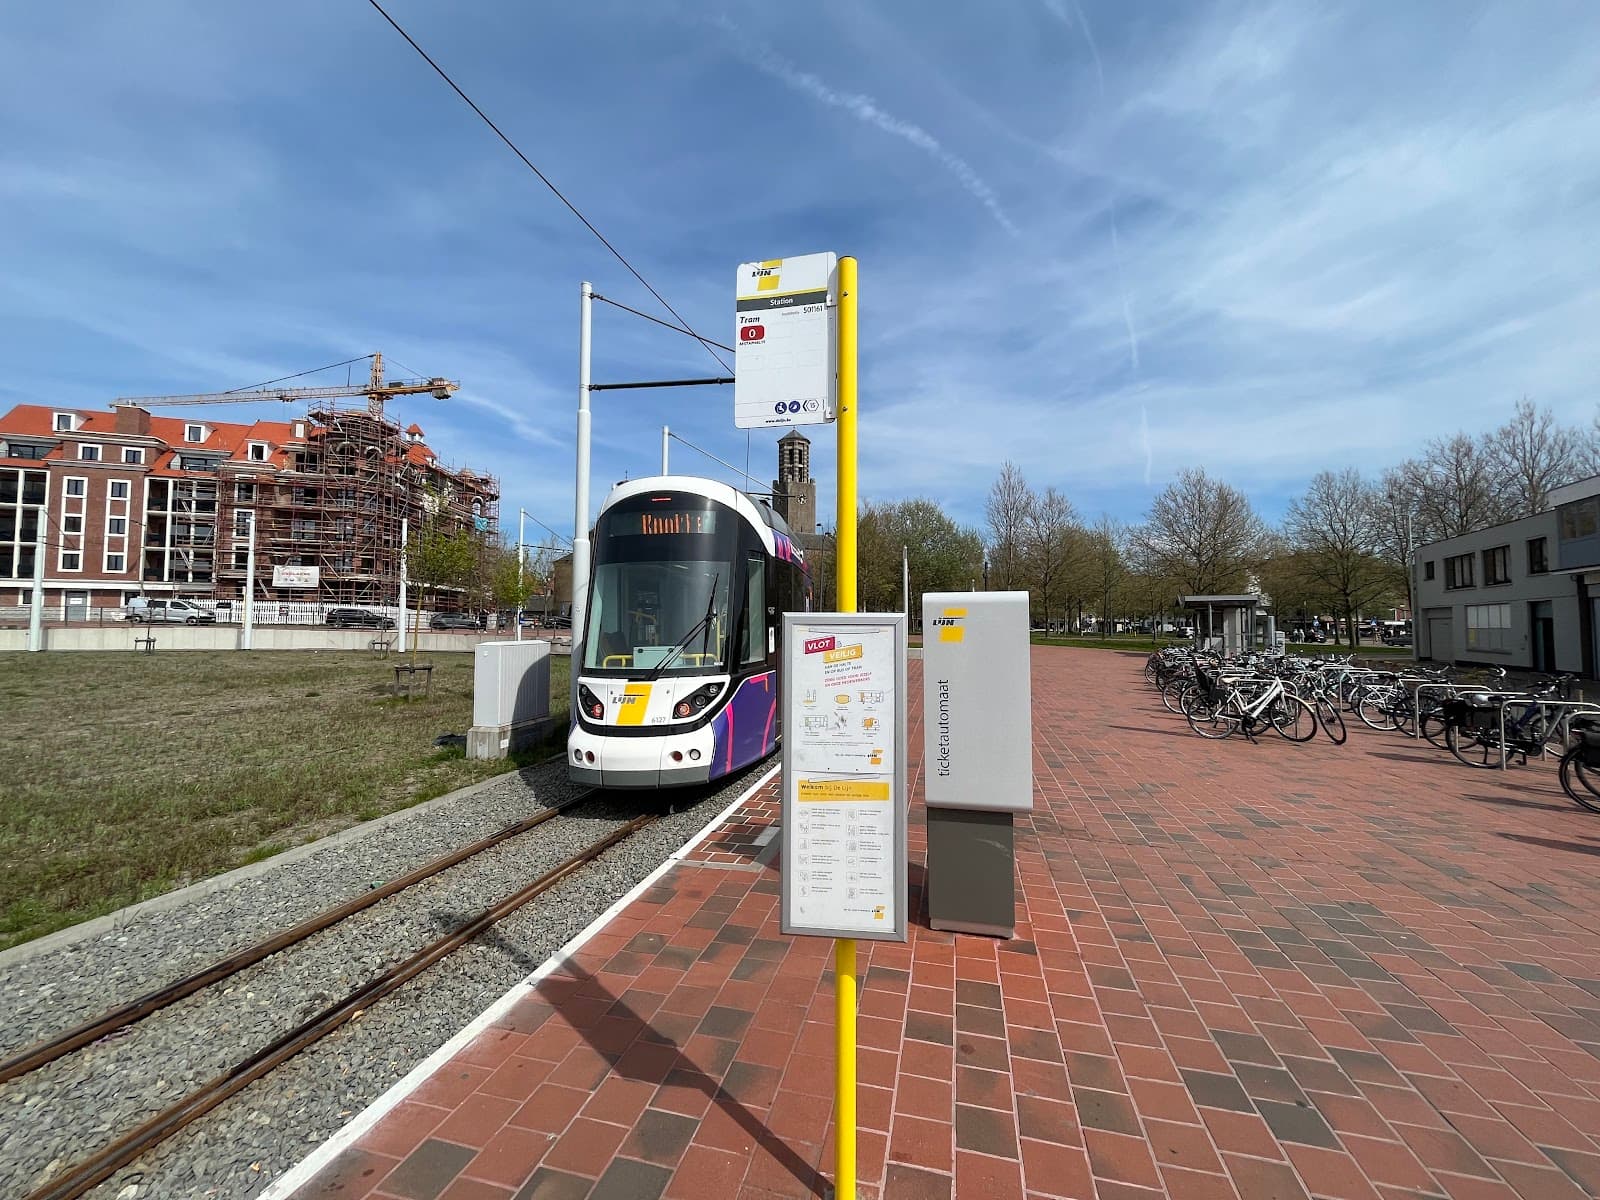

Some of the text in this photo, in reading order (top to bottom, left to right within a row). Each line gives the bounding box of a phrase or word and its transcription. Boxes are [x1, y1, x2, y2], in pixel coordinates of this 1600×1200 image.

[769, 298, 794, 306] Station
[803, 305, 823, 314] 501161
[739, 316, 760, 324] Tram
[748, 328, 756, 338] 0
[807, 640, 831, 650] VLOT
[829, 648, 857, 660] VEILIG
[937, 679, 950, 777] ticketautomaat
